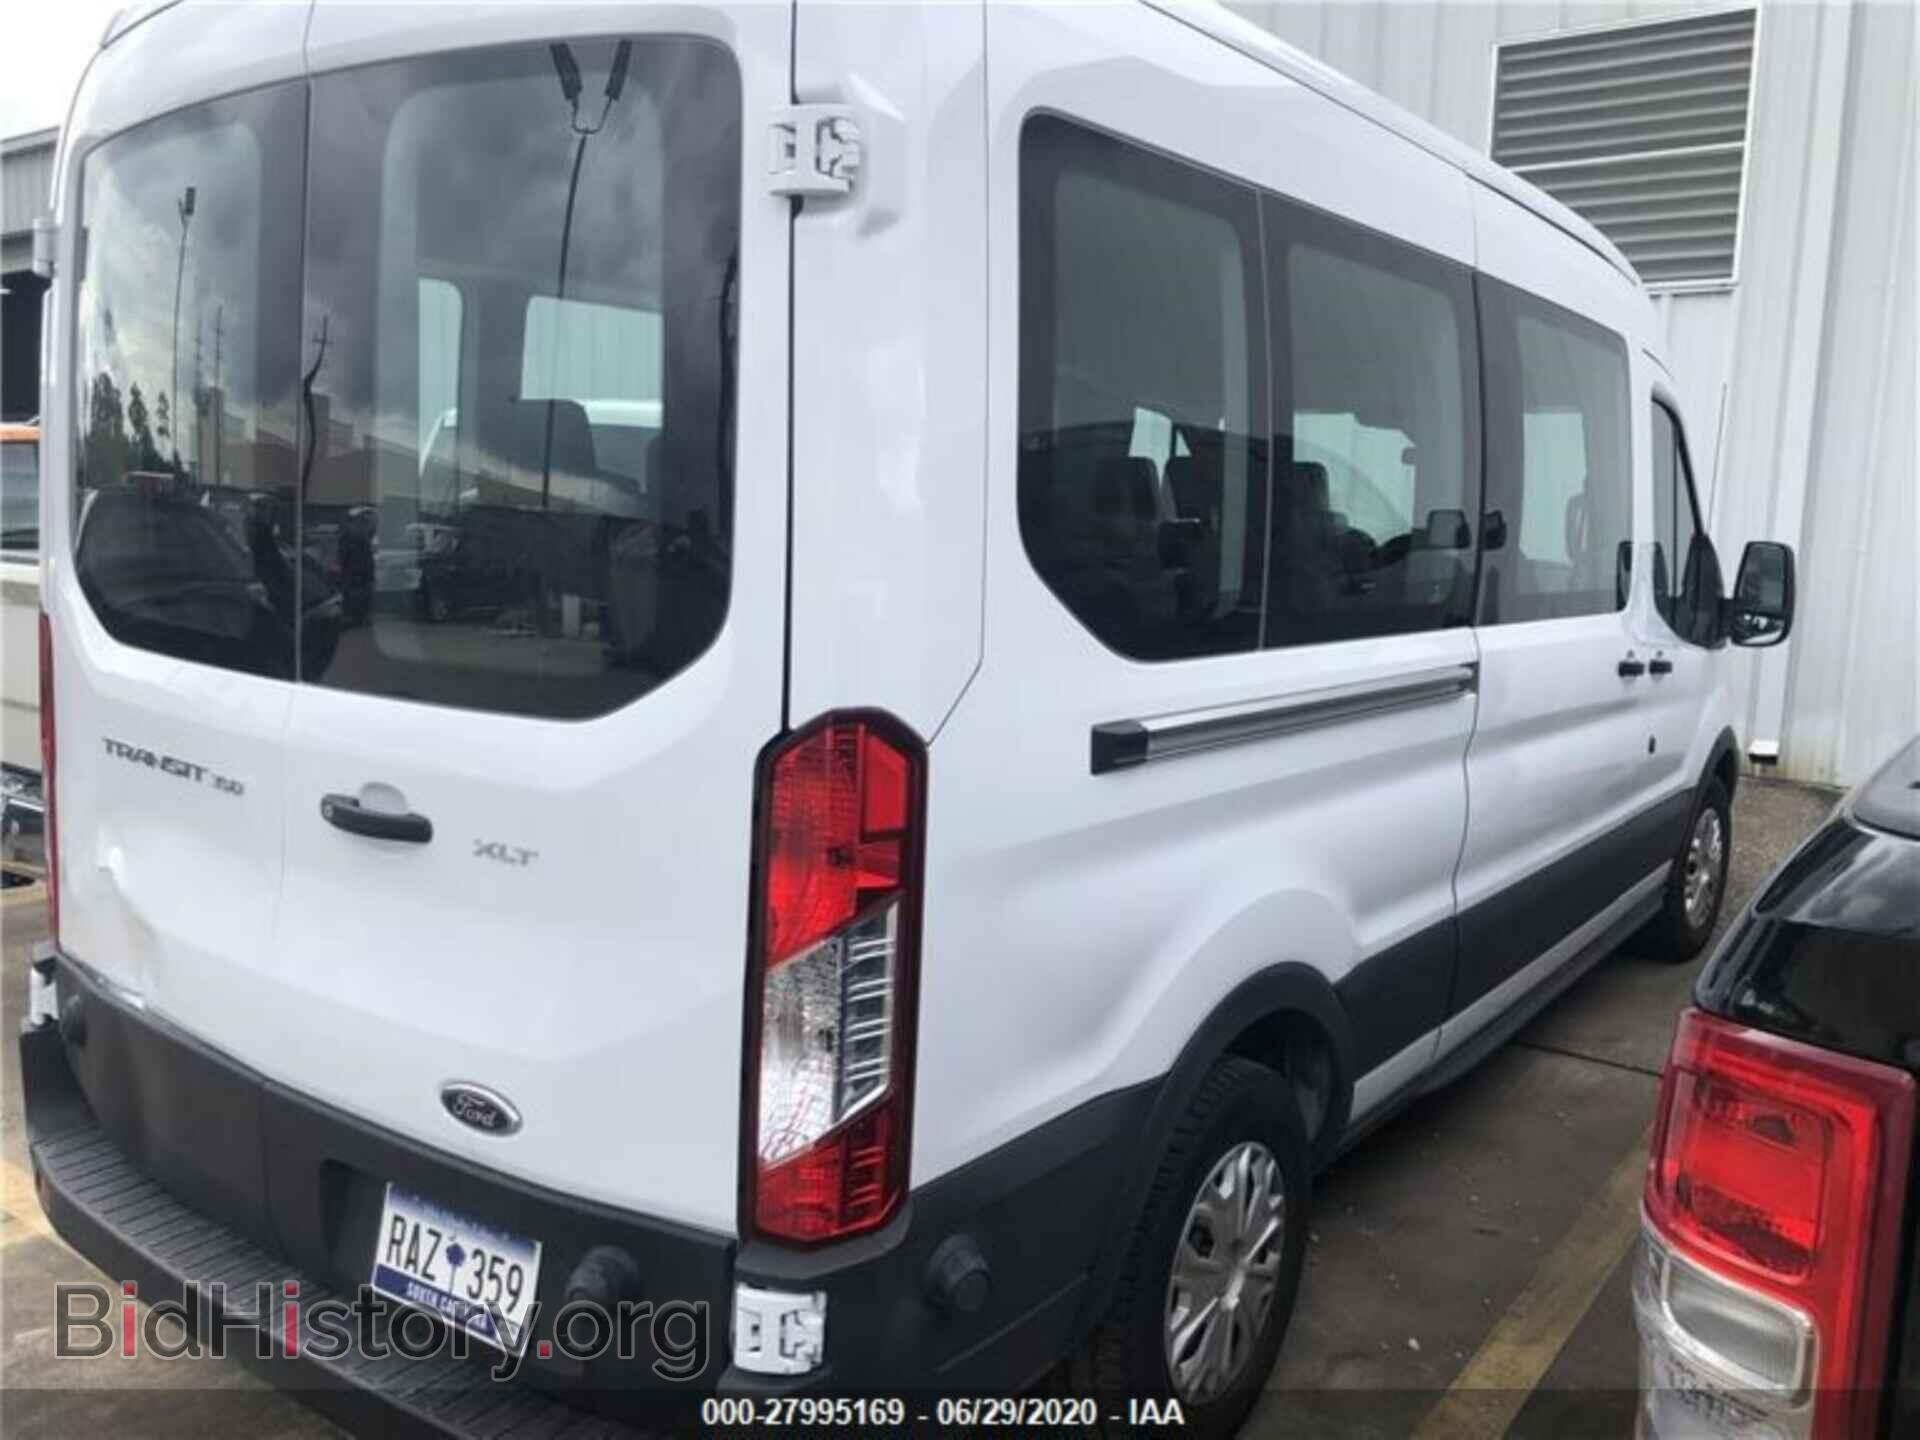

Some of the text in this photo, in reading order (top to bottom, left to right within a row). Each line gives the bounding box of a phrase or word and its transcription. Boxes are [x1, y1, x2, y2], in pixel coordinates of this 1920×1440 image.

[101, 736, 208, 782] TRANSIT
[473, 838, 540, 867] XLT
[452, 1092, 497, 1128] Ford
[386, 1215, 524, 1314] RAZ 359
